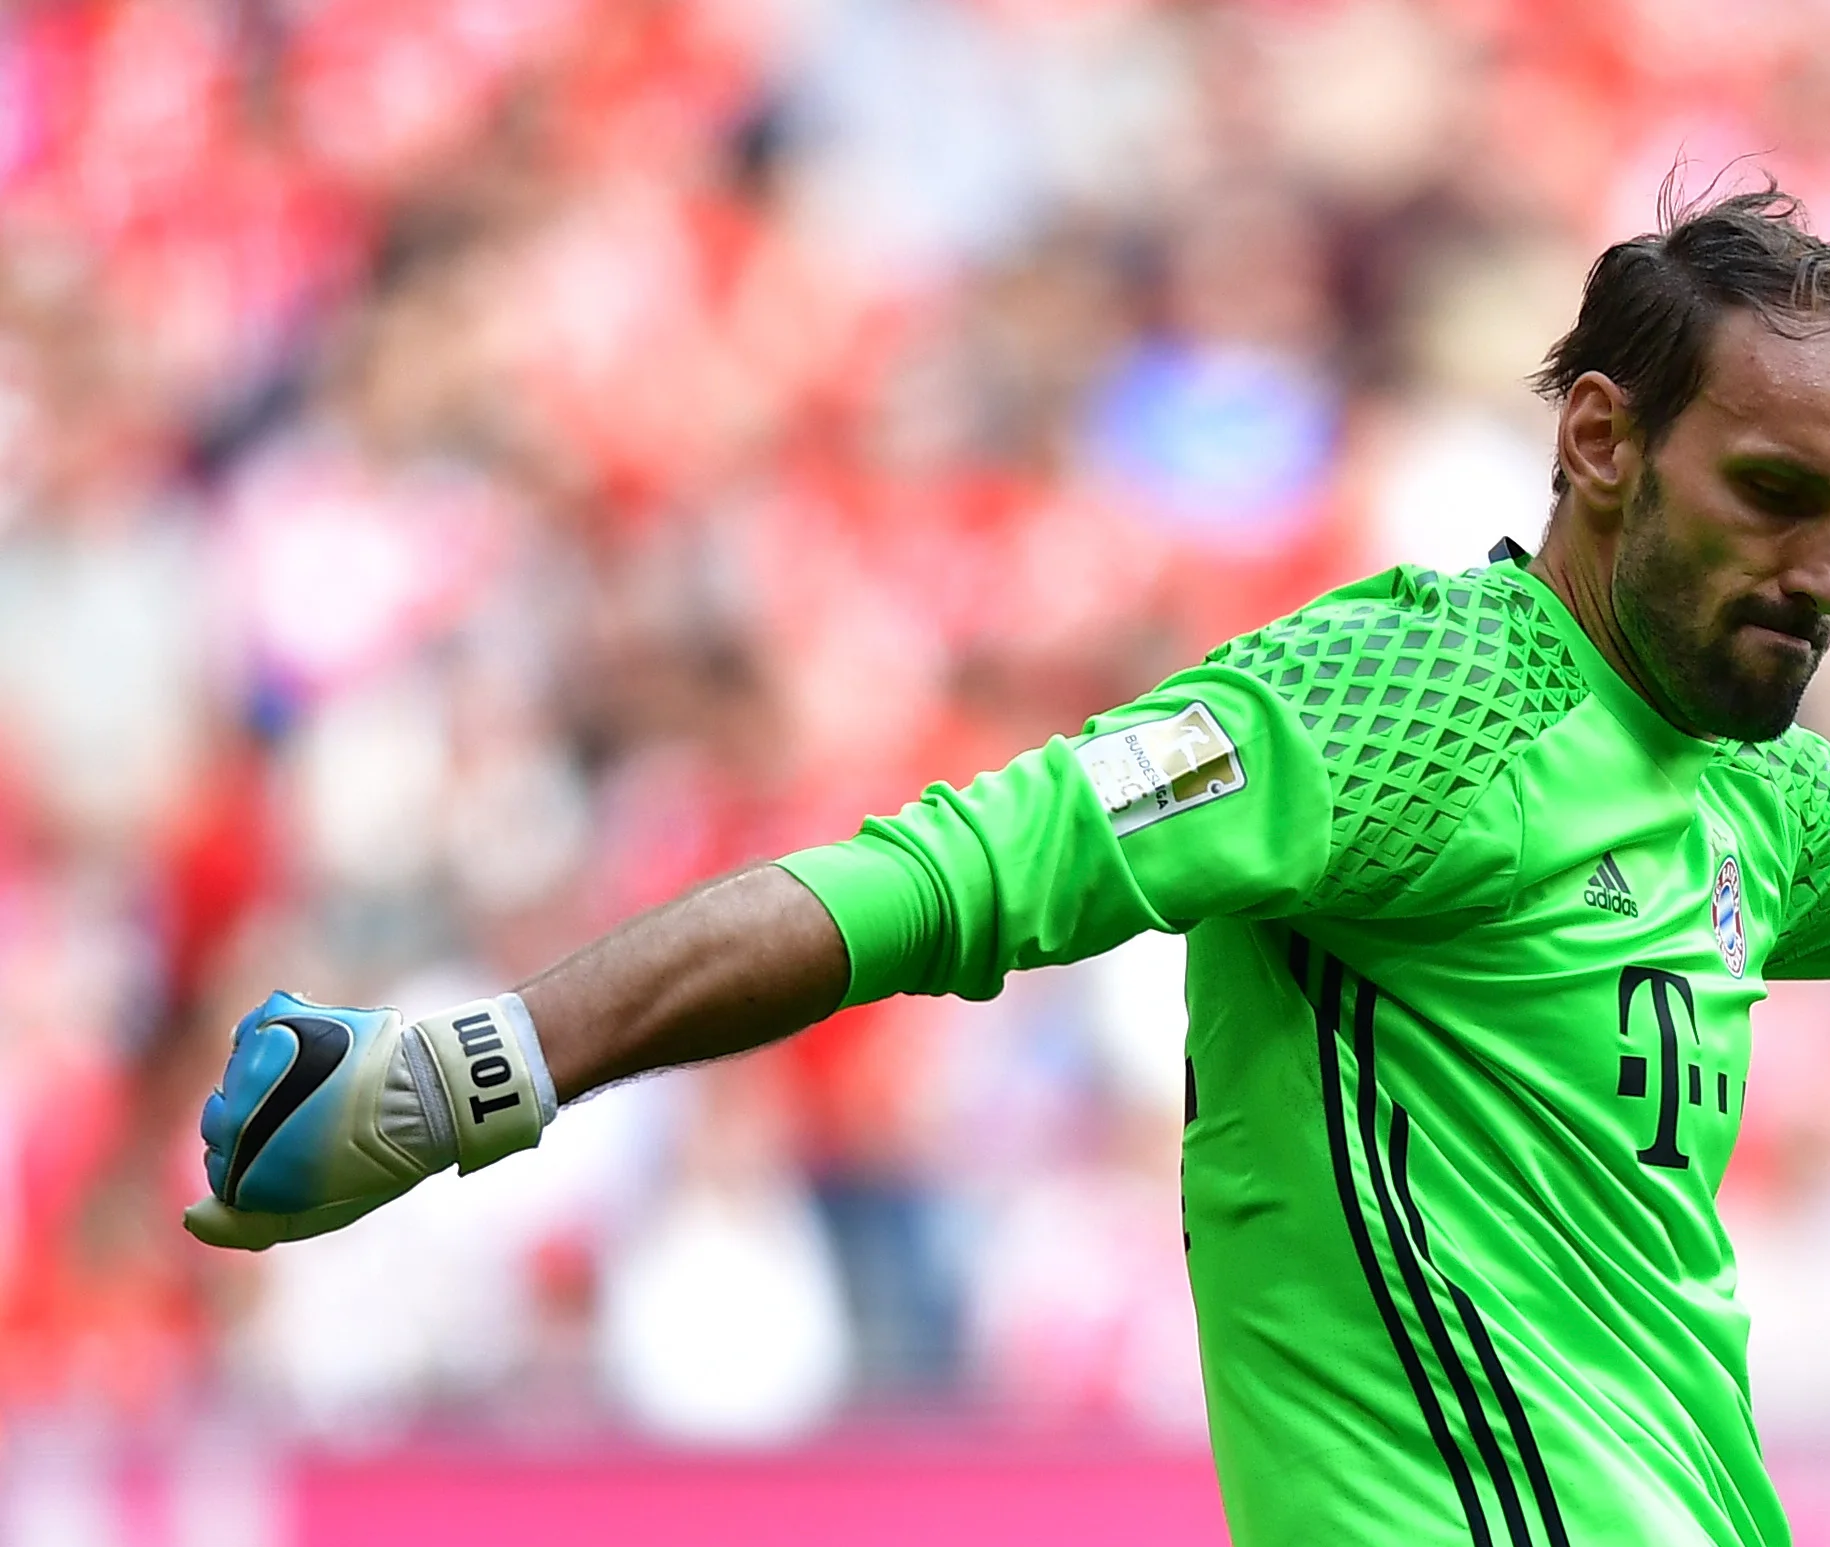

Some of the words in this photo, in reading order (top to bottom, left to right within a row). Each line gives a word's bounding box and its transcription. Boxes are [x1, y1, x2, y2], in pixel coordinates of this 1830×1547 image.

[1124, 733, 1169, 810] BUNDESLIGA
[1584, 887, 1639, 918] adidas
[453, 1012, 520, 1125] Tom
